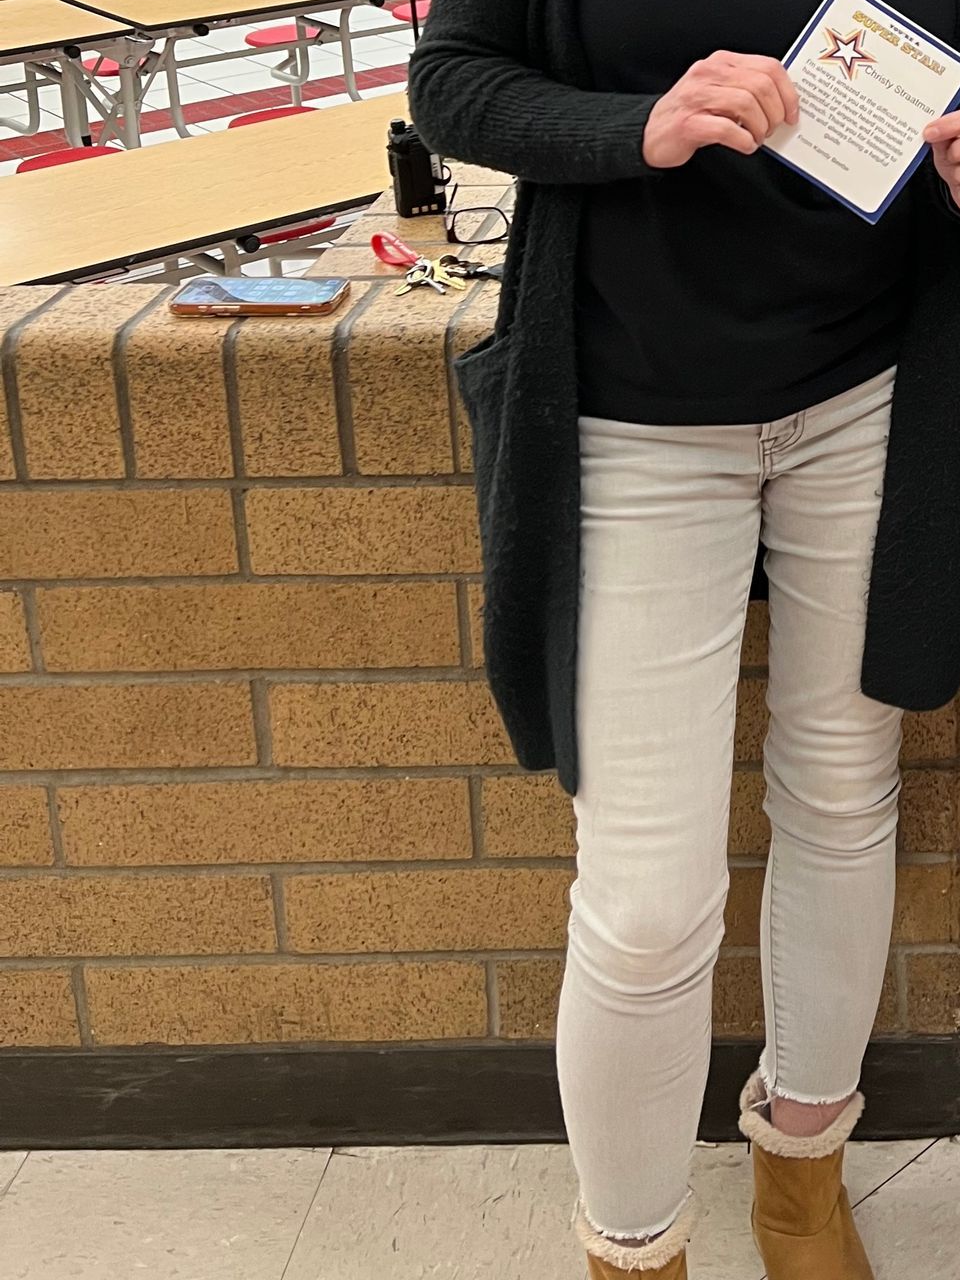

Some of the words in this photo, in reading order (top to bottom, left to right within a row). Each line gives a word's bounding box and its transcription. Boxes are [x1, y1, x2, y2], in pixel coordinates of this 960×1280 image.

[851, 9, 902, 46] SUPER
[899, 41, 946, 76] STAR!
[862, 64, 895, 90] Christy
[892, 84, 936, 117] Straatman
